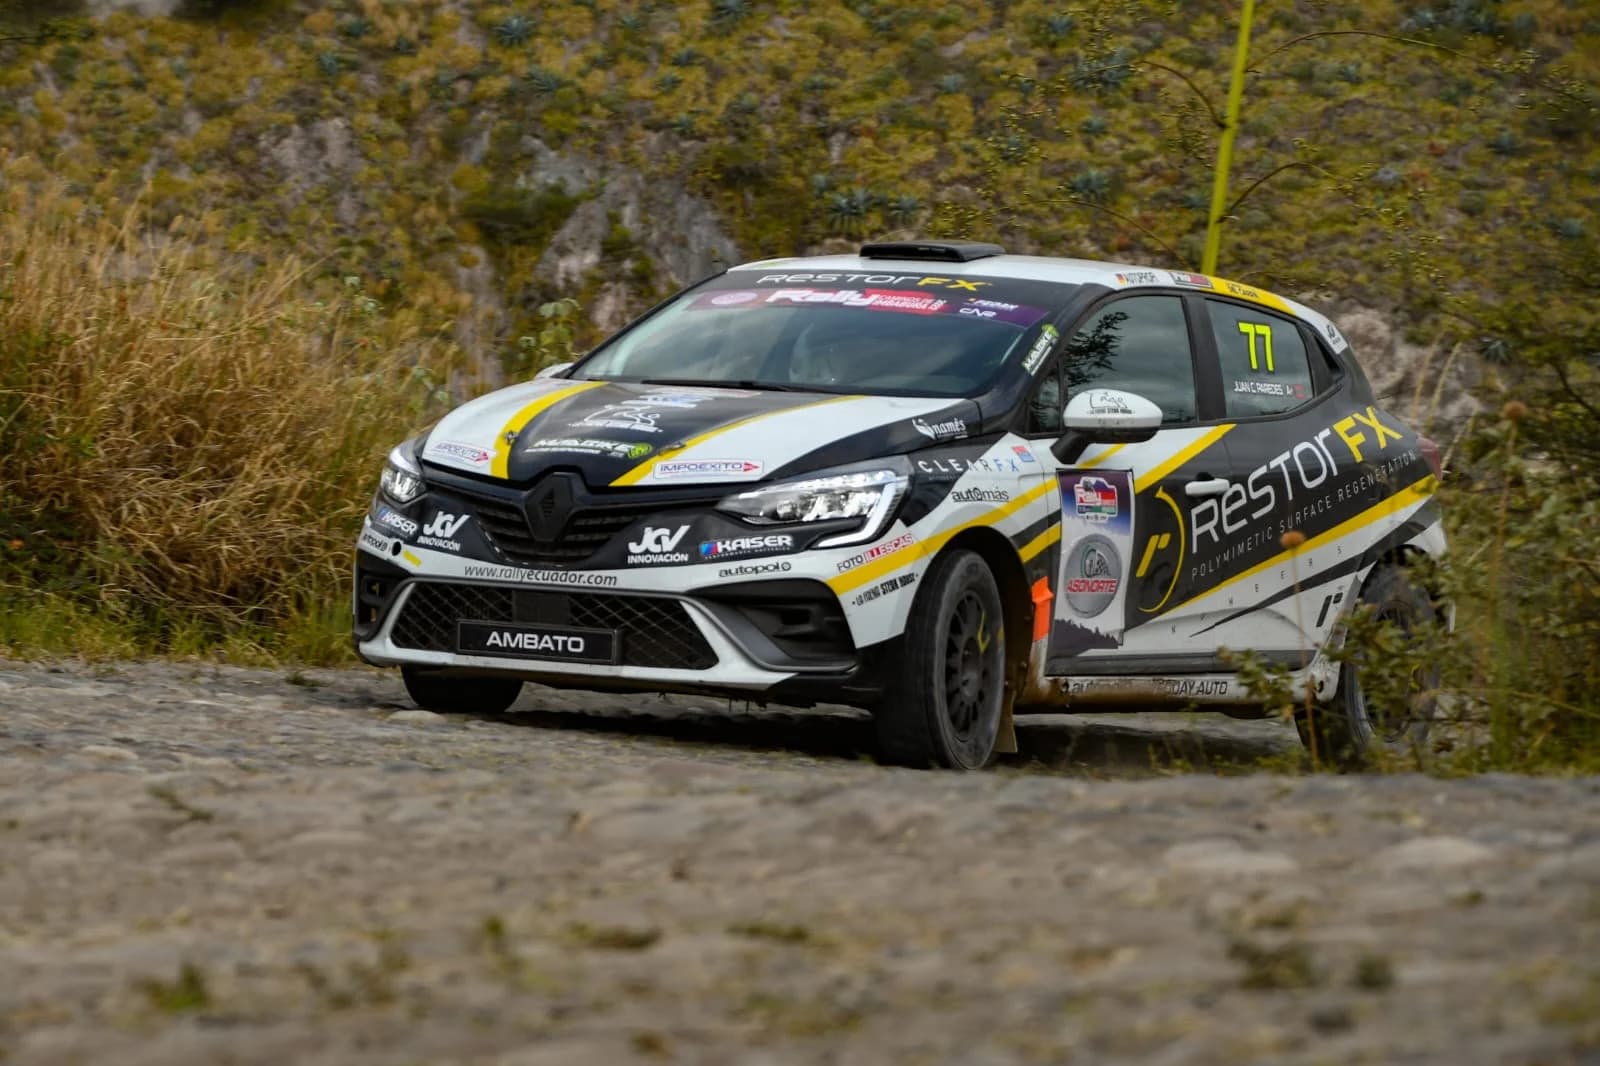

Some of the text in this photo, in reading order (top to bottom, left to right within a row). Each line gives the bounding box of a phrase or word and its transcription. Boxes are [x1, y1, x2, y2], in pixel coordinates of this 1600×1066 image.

[766, 289, 880, 307] Rally
[1238, 320, 1275, 373] 77
[660, 462, 743, 473] IMPOEXITO
[423, 510, 472, 538] JCV
[1191, 449, 1418, 583] POLYMIMETIC SURFACE REGENERATION
[628, 525, 691, 553] JCV
[717, 535, 794, 553] KAISER
[627, 550, 689, 564] INNOVACIÓN
[837, 554, 864, 573] FOTO
[464, 563, 618, 586] www.rallyecuador.com
[486, 630, 585, 653] AMBATO
